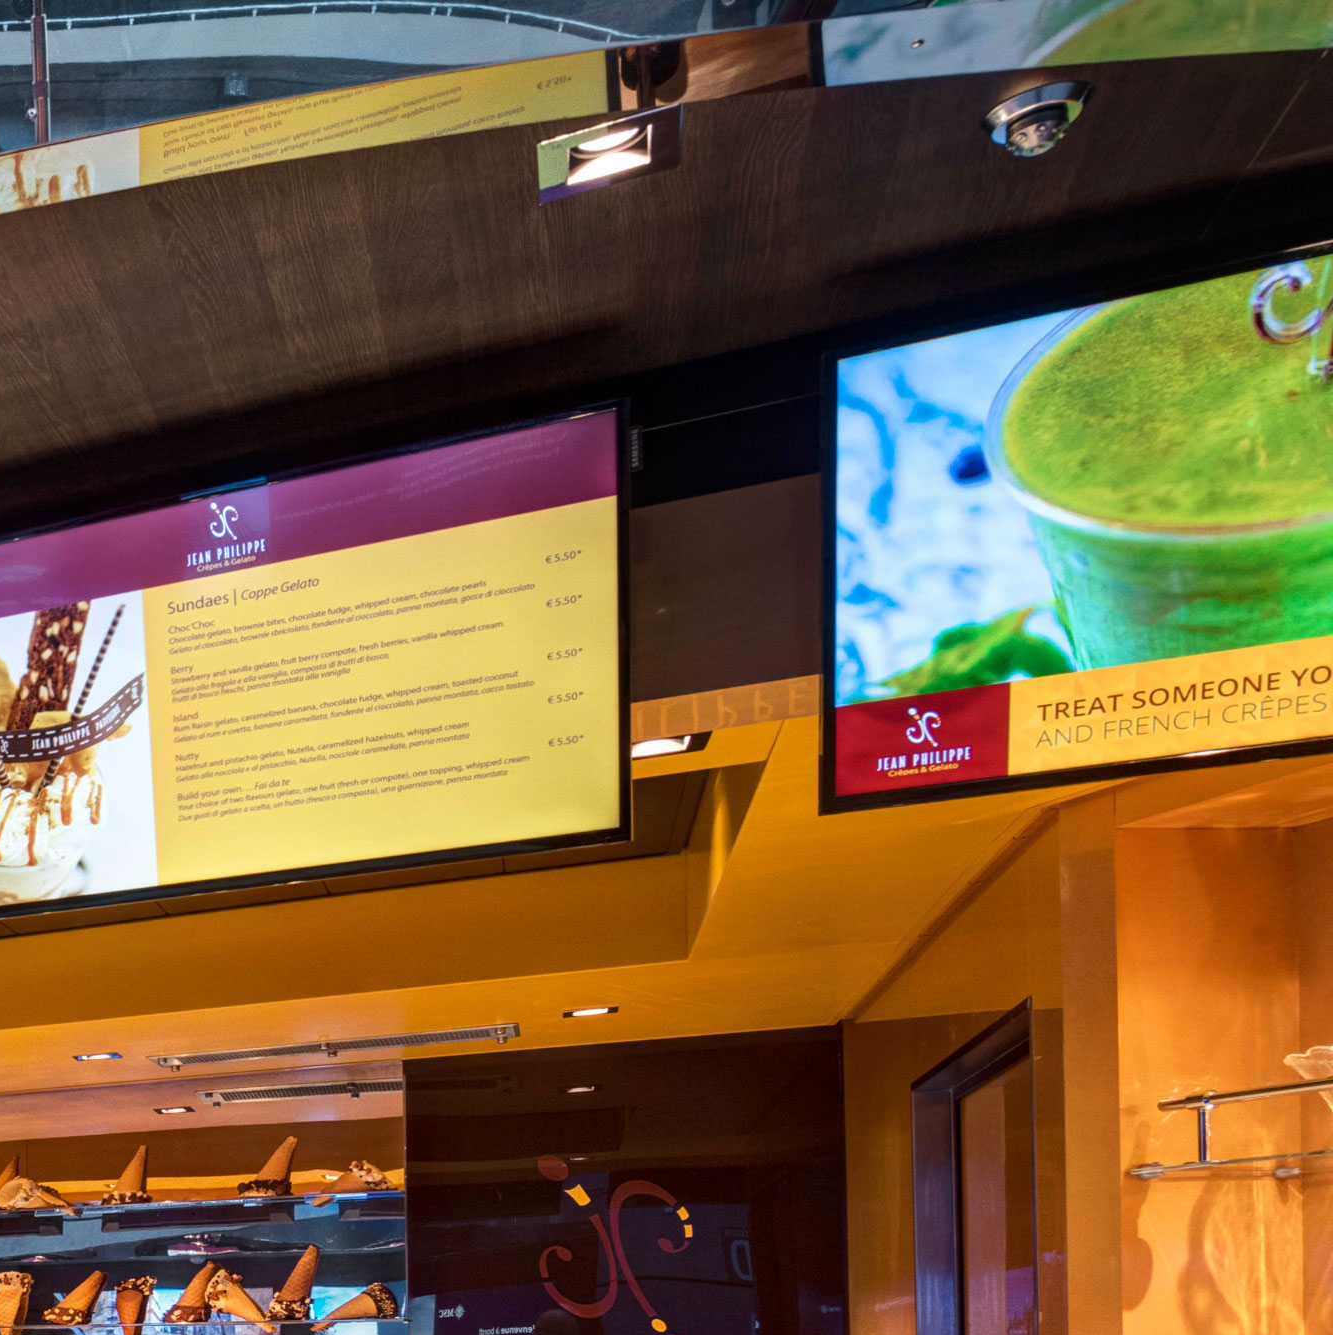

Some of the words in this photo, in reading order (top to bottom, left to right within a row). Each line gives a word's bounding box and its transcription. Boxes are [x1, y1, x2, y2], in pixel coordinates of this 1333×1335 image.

[187, 550, 212, 567] JEAN
[217, 538, 266, 561] PHILIPPE
[167, 590, 229, 615] Sundaes
[240, 583, 278, 603] Coppe
[280, 575, 320, 593] Gelato
[170, 662, 193, 676] Berry
[1037, 693, 1118, 722] TREAT
[1132, 672, 1282, 710] SOMEONE
[172, 711, 198, 723] Island
[1035, 722, 1094, 748] AND
[1104, 708, 1211, 740] FRENCH
[1222, 691, 1329, 725] CRÊPES
[174, 751, 200, 763] Nutty
[876, 755, 907, 772] JEAN
[912, 746, 971, 767] PHILIPPE
[176, 790, 199, 801] Build
[200, 789, 220, 799] your
[254, 780, 267, 790] Fai
[268, 778, 280, 788] da
[281, 778, 290, 786] te
